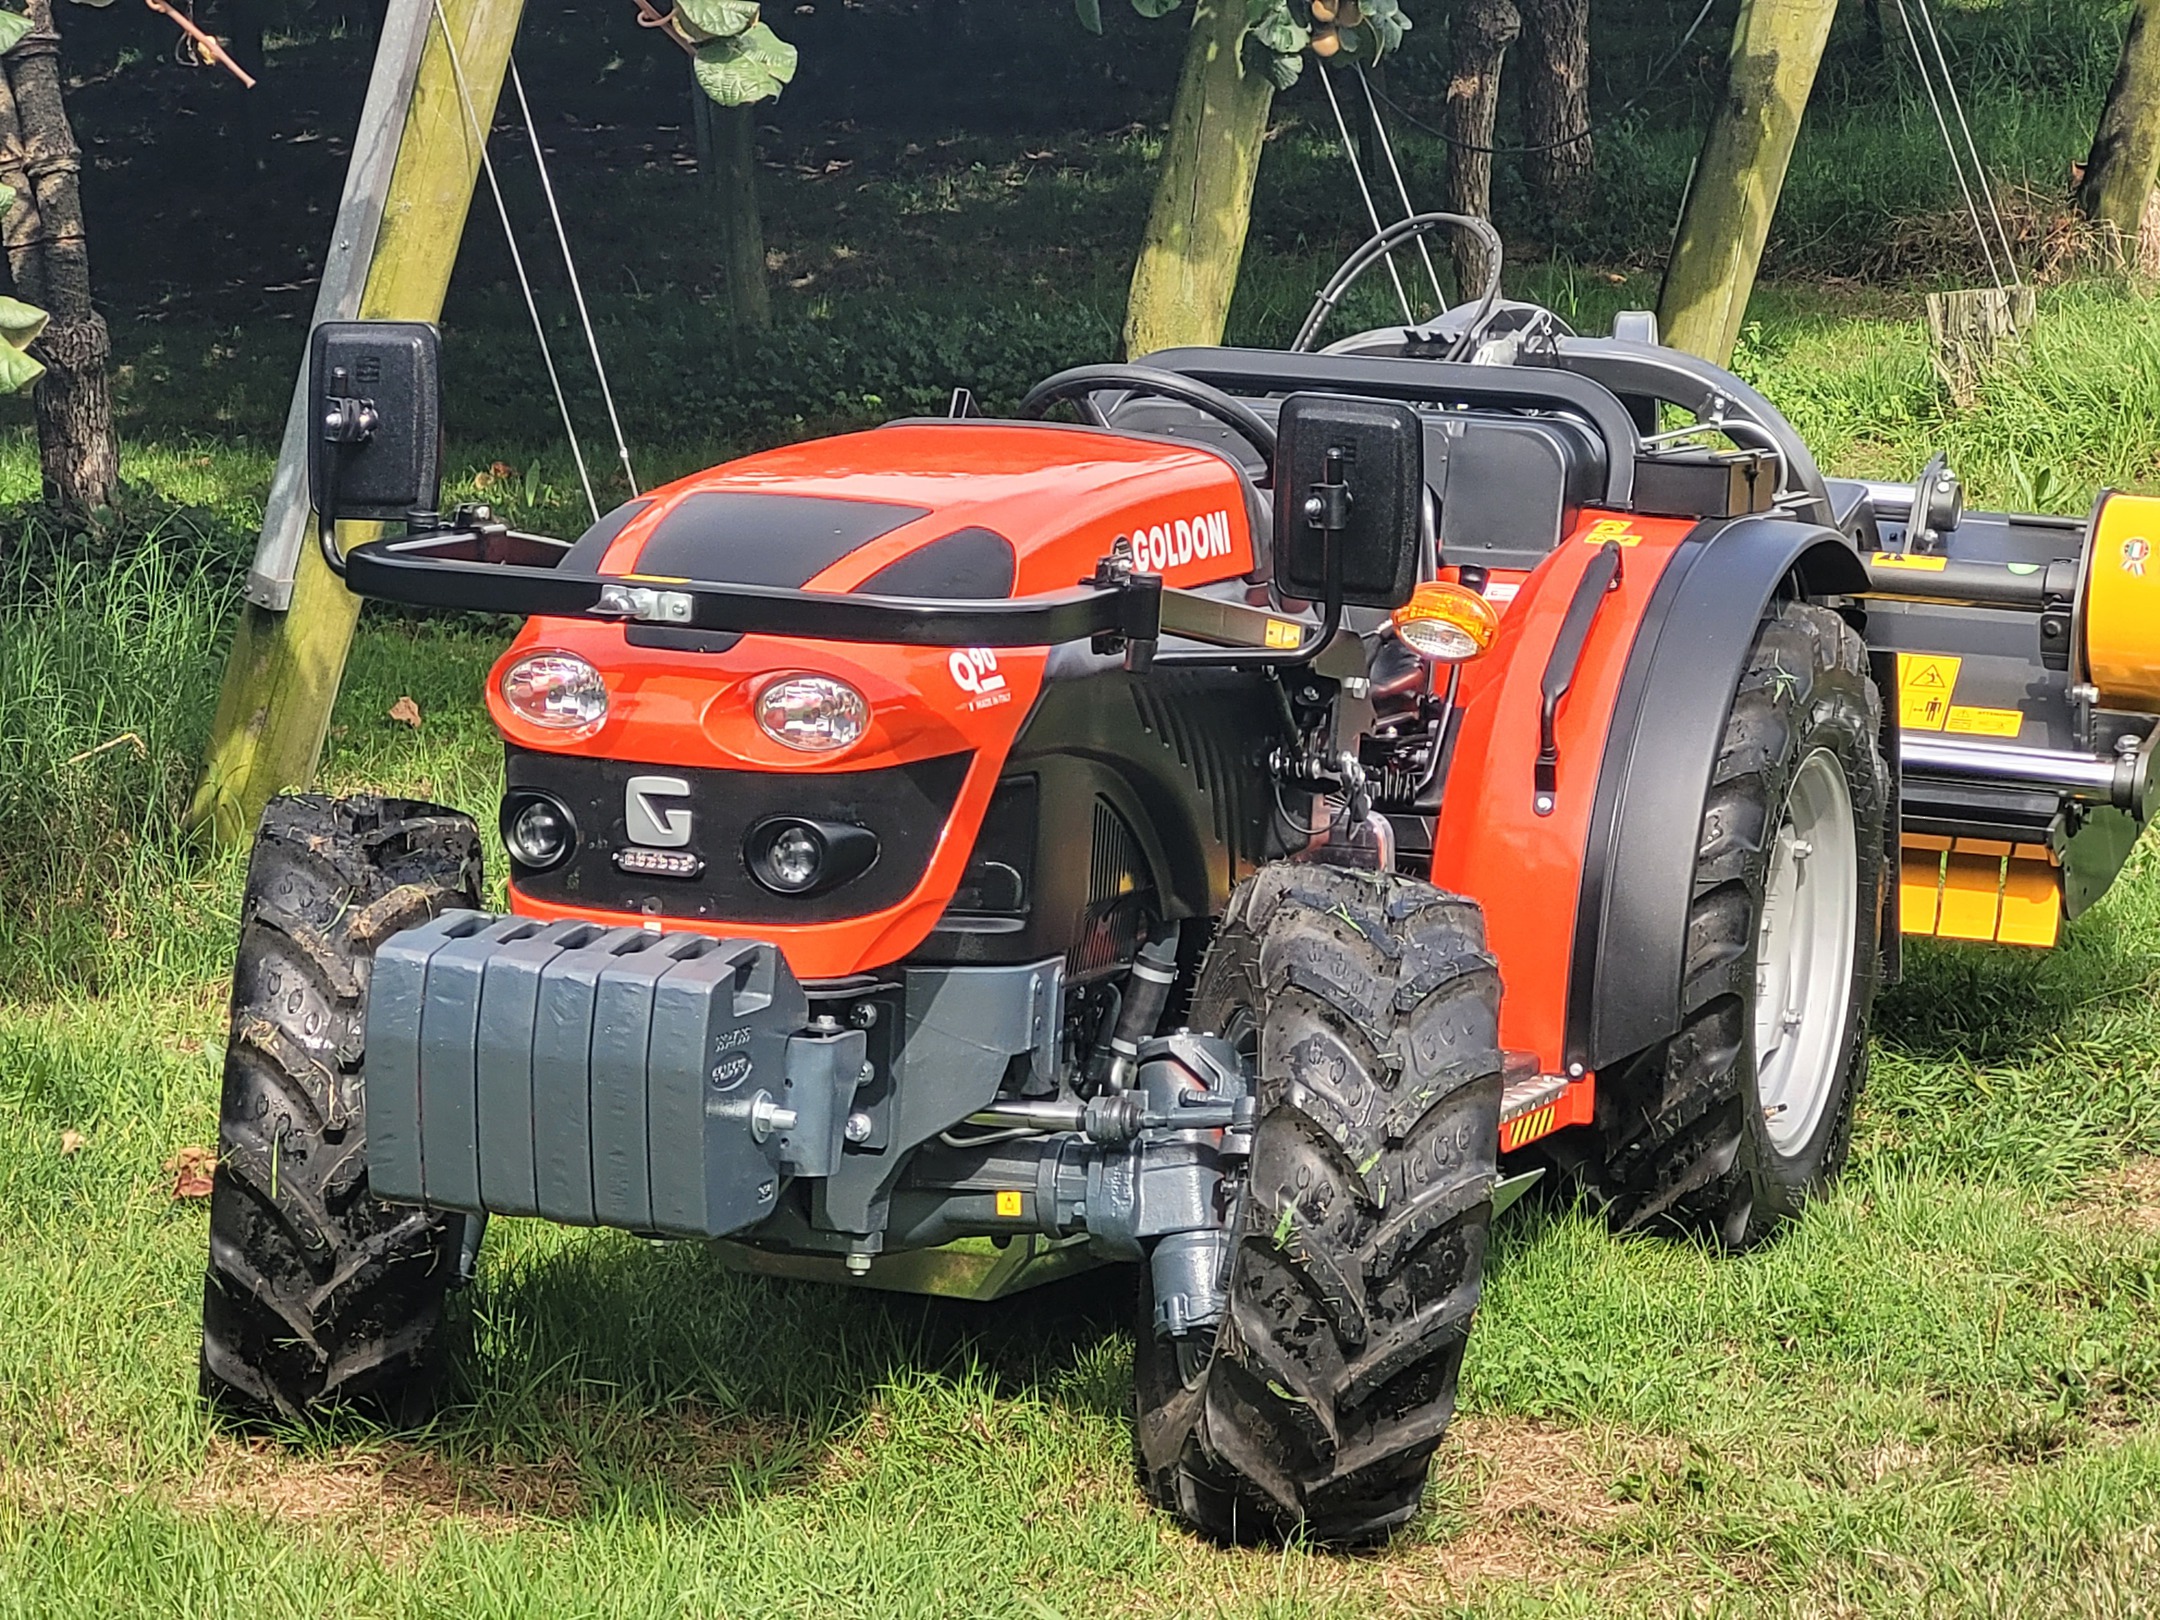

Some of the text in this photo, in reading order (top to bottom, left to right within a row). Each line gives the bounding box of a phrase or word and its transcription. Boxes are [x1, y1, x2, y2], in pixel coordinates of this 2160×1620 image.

[1132, 510, 1232, 572] GOLDONI
[948, 647, 998, 694] Q90
[625, 776, 692, 847] G
